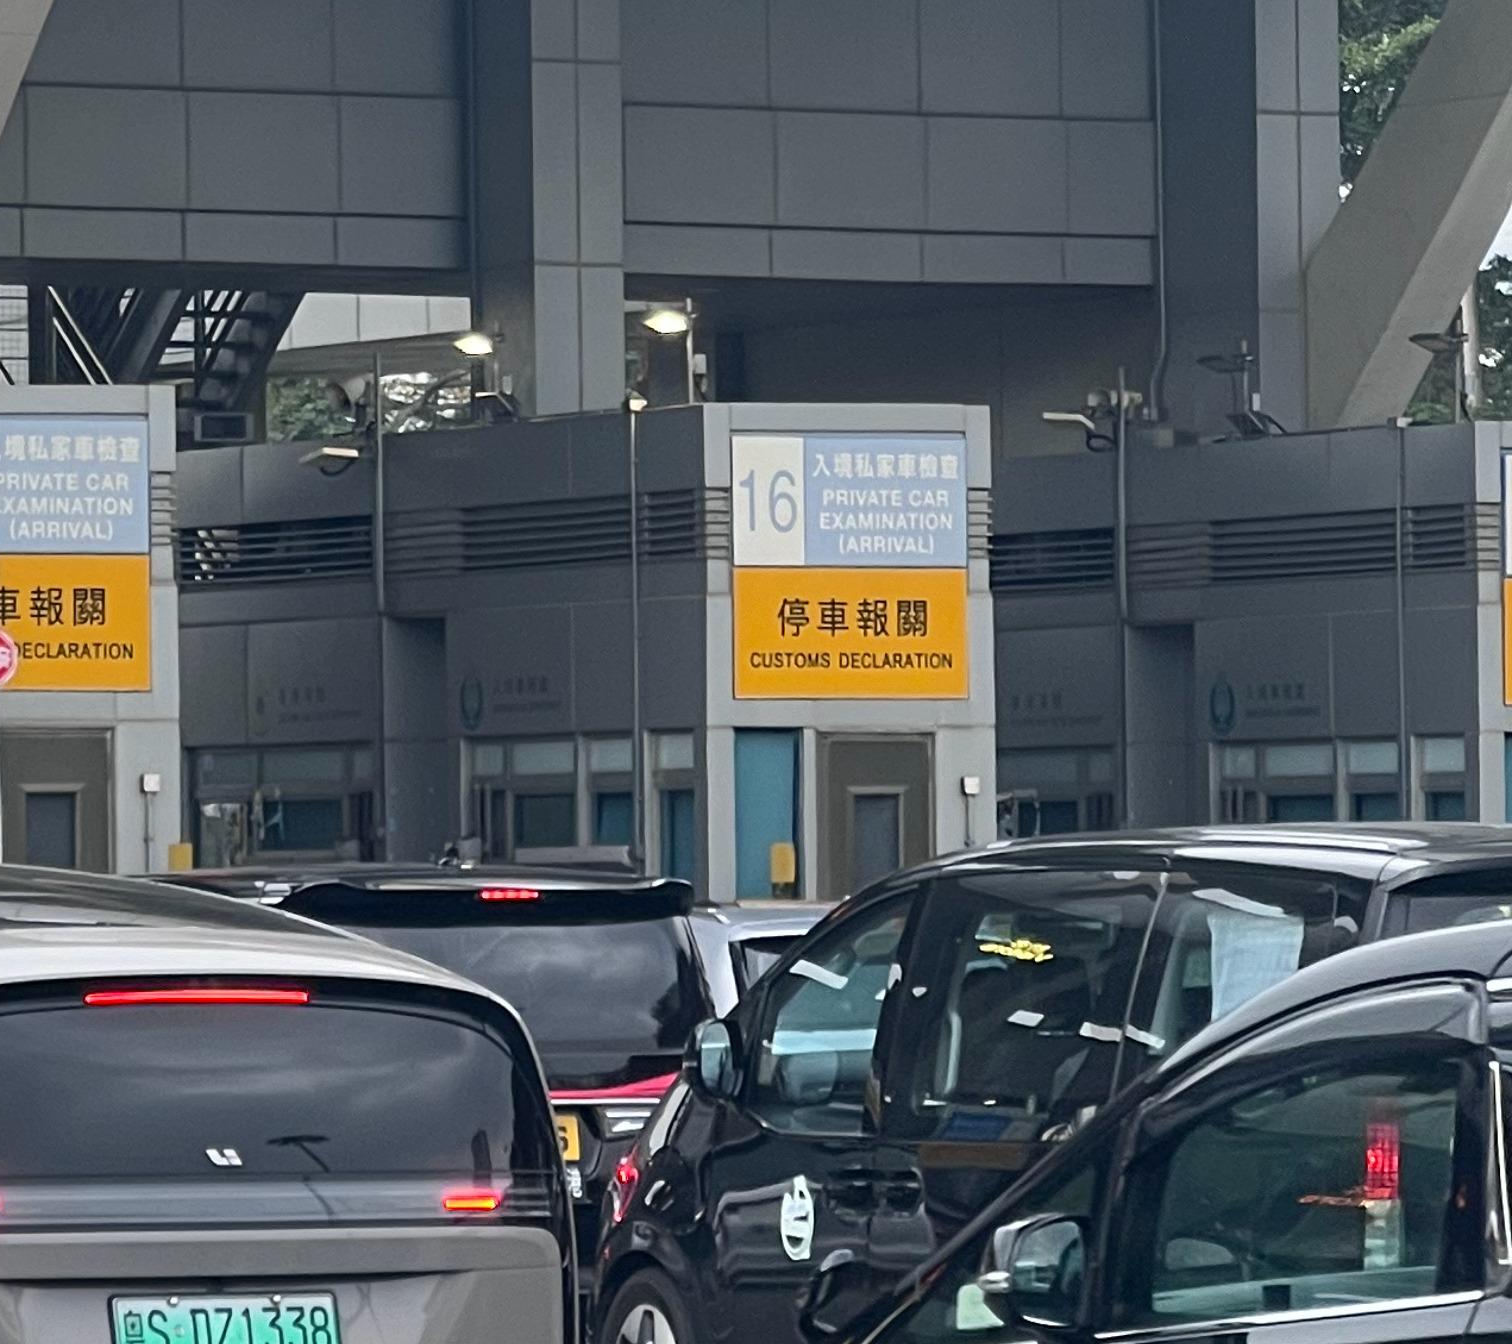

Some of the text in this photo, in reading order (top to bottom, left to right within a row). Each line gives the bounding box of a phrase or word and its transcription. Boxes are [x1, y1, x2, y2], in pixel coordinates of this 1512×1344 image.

[85, 473, 129, 491] CAR
[739, 469, 798, 534] 16
[822, 489, 949, 507] PRIVATE CAR
[9, 517, 114, 541] (ARRIVAL)
[819, 512, 953, 530] EXAMINATION
[839, 533, 934, 555] (ARRIVAL)
[777, 598, 928, 637] 停車報關
[750, 652, 953, 669] CUSTOMS DECLARATION
